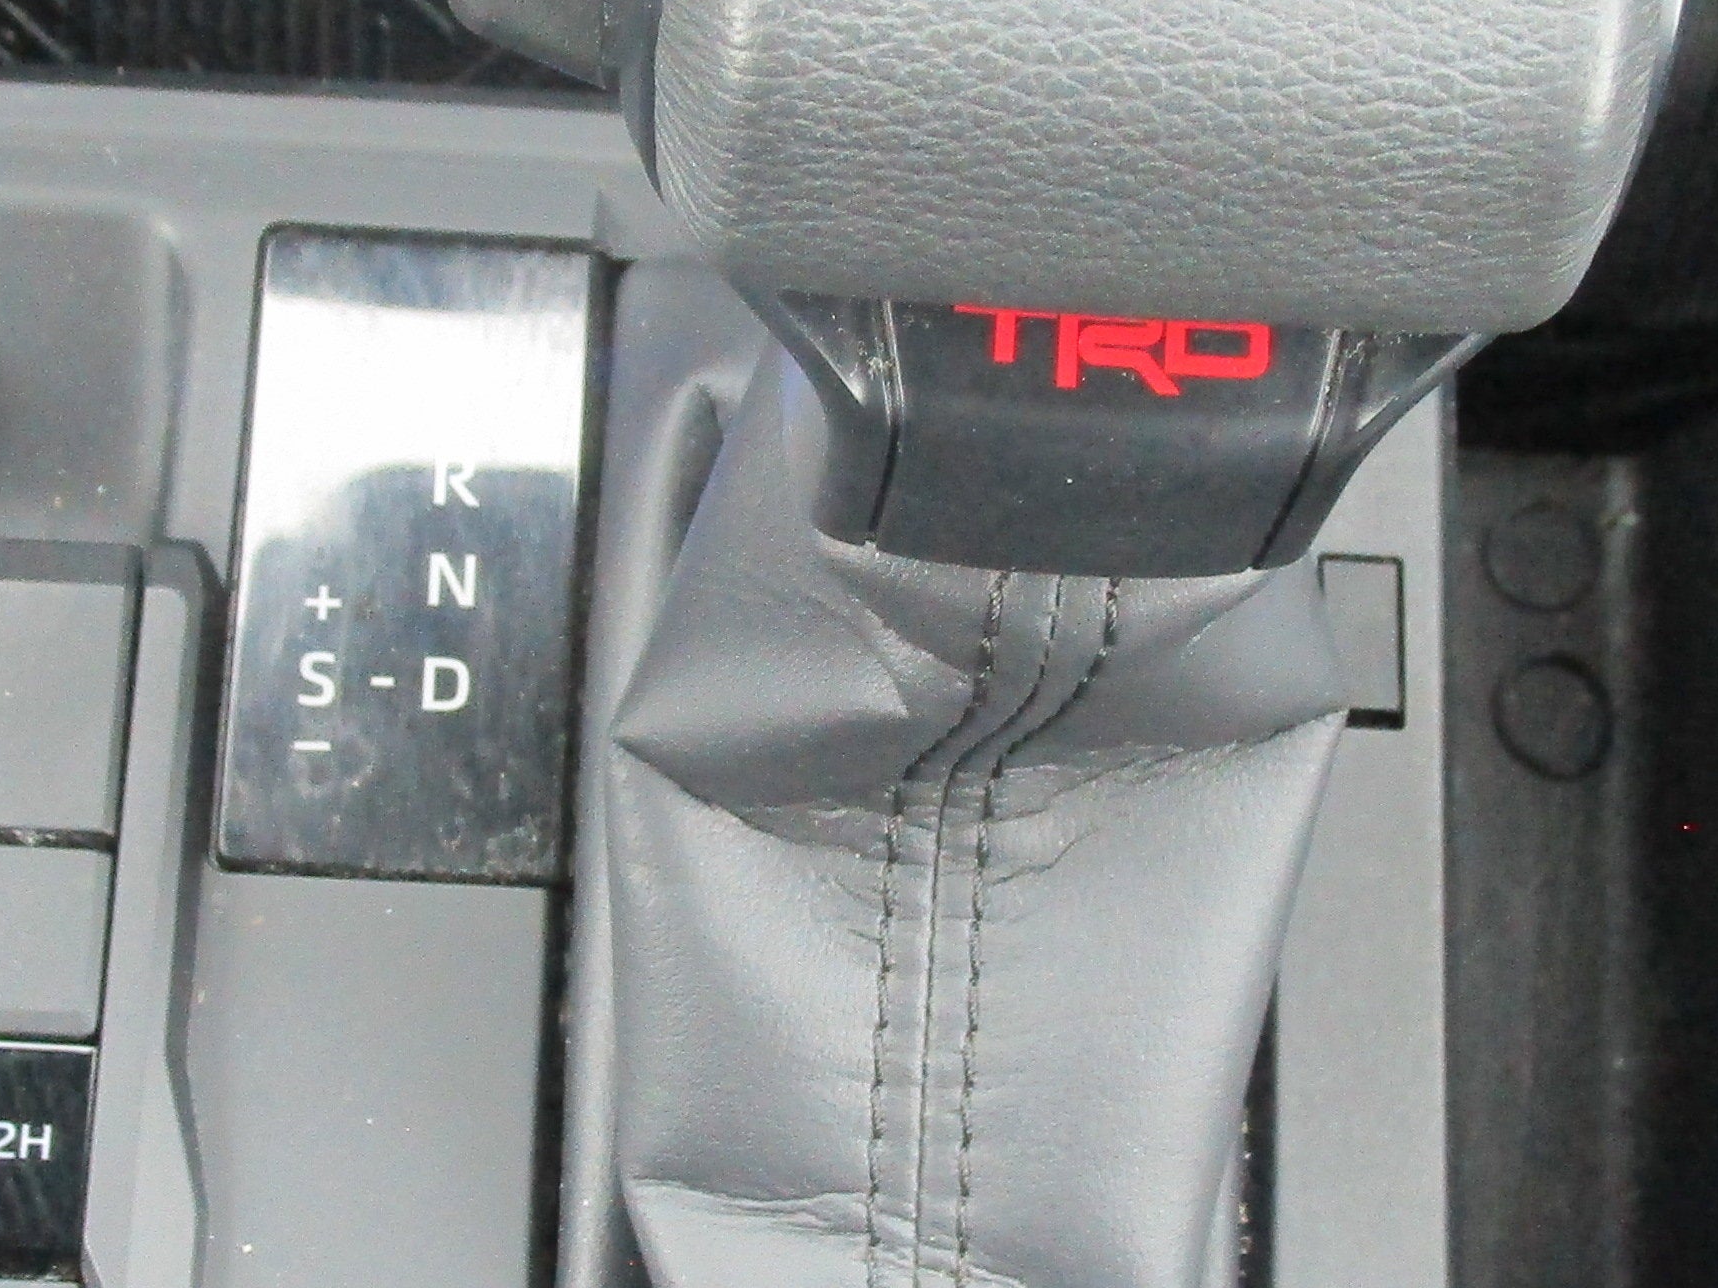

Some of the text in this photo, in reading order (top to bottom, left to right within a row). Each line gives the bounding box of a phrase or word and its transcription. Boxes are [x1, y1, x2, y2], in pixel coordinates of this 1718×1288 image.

[954, 303, 1271, 397] TRD
[432, 457, 480, 509] R
[427, 553, 477, 608] N
[298, 652, 337, 706] S
[421, 657, 470, 711] D
